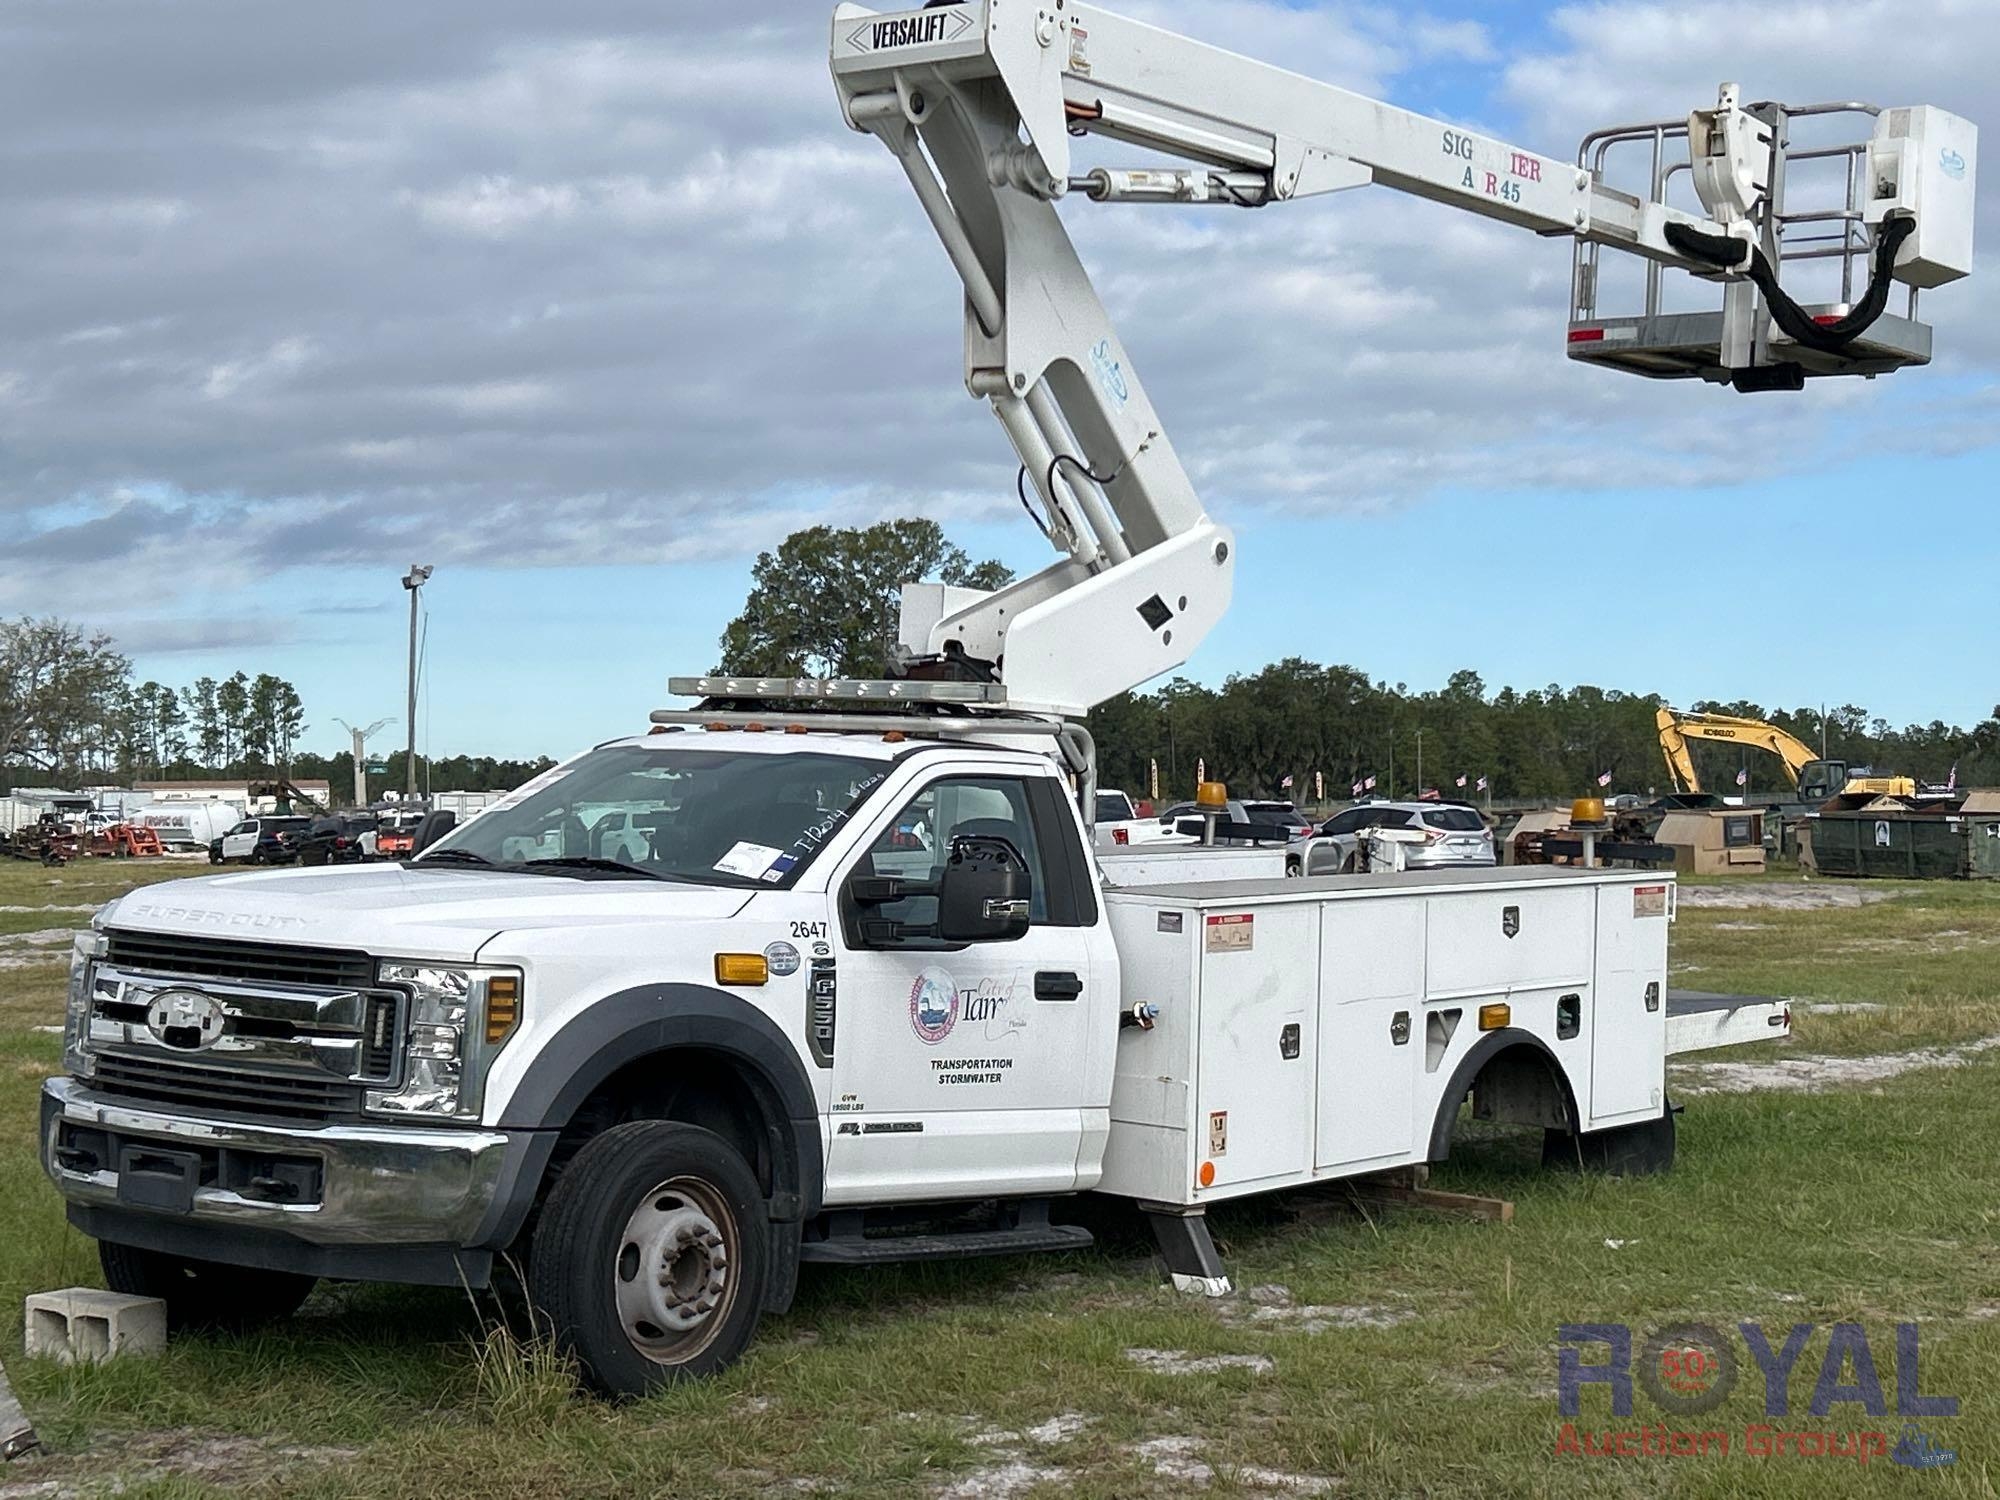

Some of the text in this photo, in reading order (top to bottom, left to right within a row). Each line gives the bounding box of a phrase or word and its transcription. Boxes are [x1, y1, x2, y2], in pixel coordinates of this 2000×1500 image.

[872, 13, 948, 50] VERSALIFT
[132, 904, 322, 929] SUPER DUTY
[789, 920, 828, 939] 2647
[930, 1058, 1013, 1071] TRANSPORTATION
[938, 1073, 1003, 1085] STORMWATER
